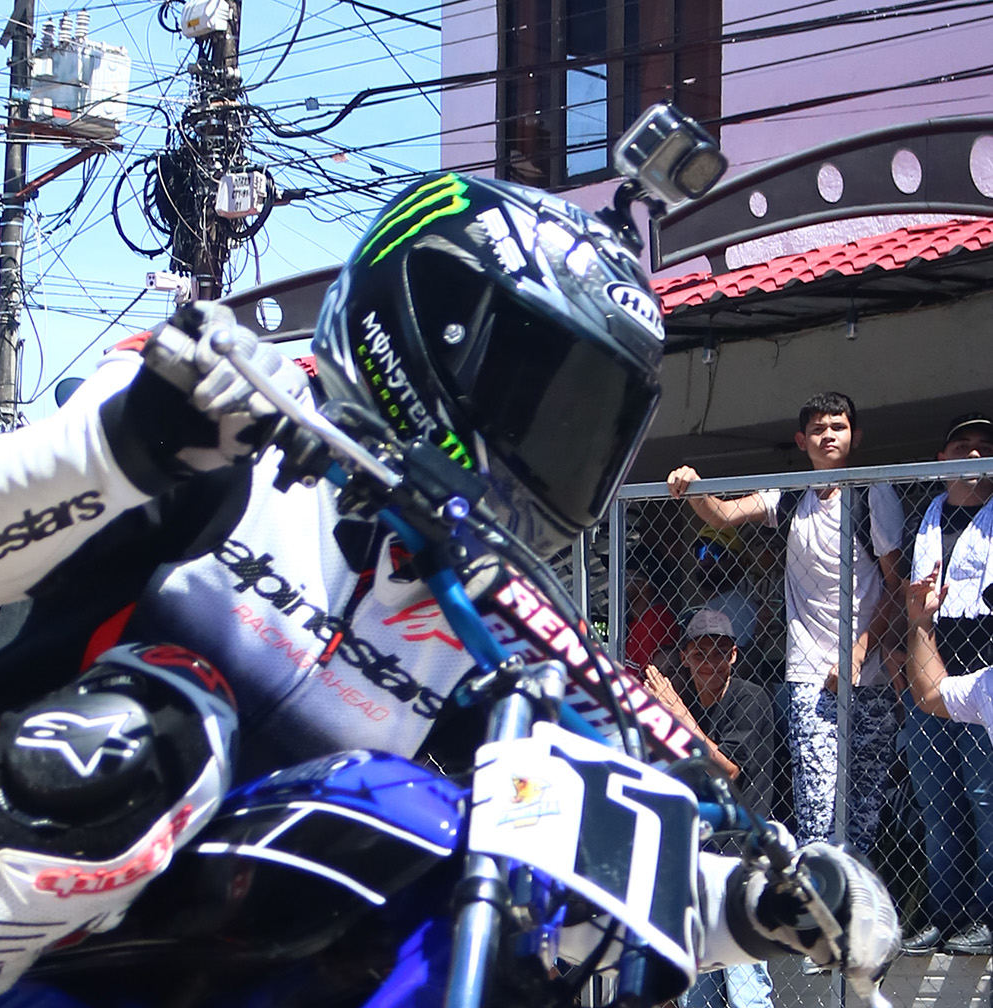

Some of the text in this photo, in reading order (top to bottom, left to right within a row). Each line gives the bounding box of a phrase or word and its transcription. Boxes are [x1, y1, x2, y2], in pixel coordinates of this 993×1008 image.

[356, 344, 409, 430] ENERGY
[361, 311, 437, 440] MONSTER
[230, 603, 318, 669] RACING
[316, 669, 390, 722] AHEAD
